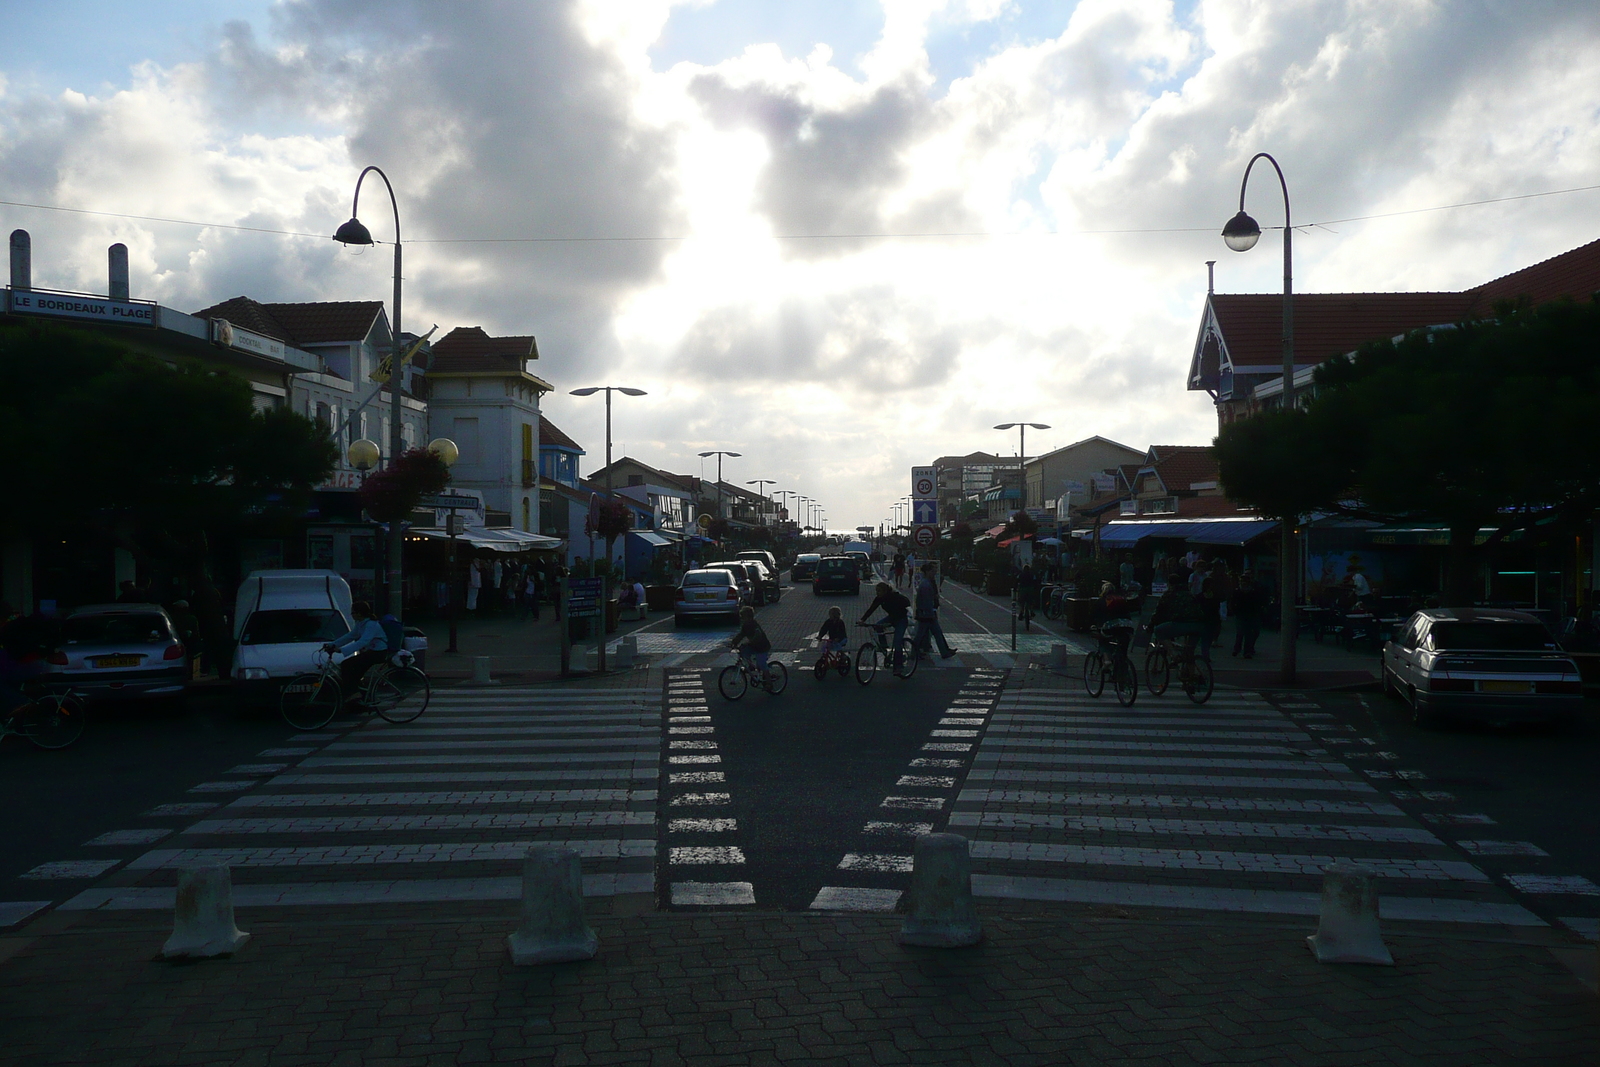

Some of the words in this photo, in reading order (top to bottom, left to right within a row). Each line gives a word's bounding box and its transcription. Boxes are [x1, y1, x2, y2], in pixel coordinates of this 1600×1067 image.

[15, 297, 30, 306] LE
[38, 300, 105, 314] BORDEAUX
[113, 307, 151, 318] PLAGE
[239, 336, 262, 349] COCKTAIL
[920, 483, 930, 491] 30
[443, 498, 476, 507] CENTRALE
